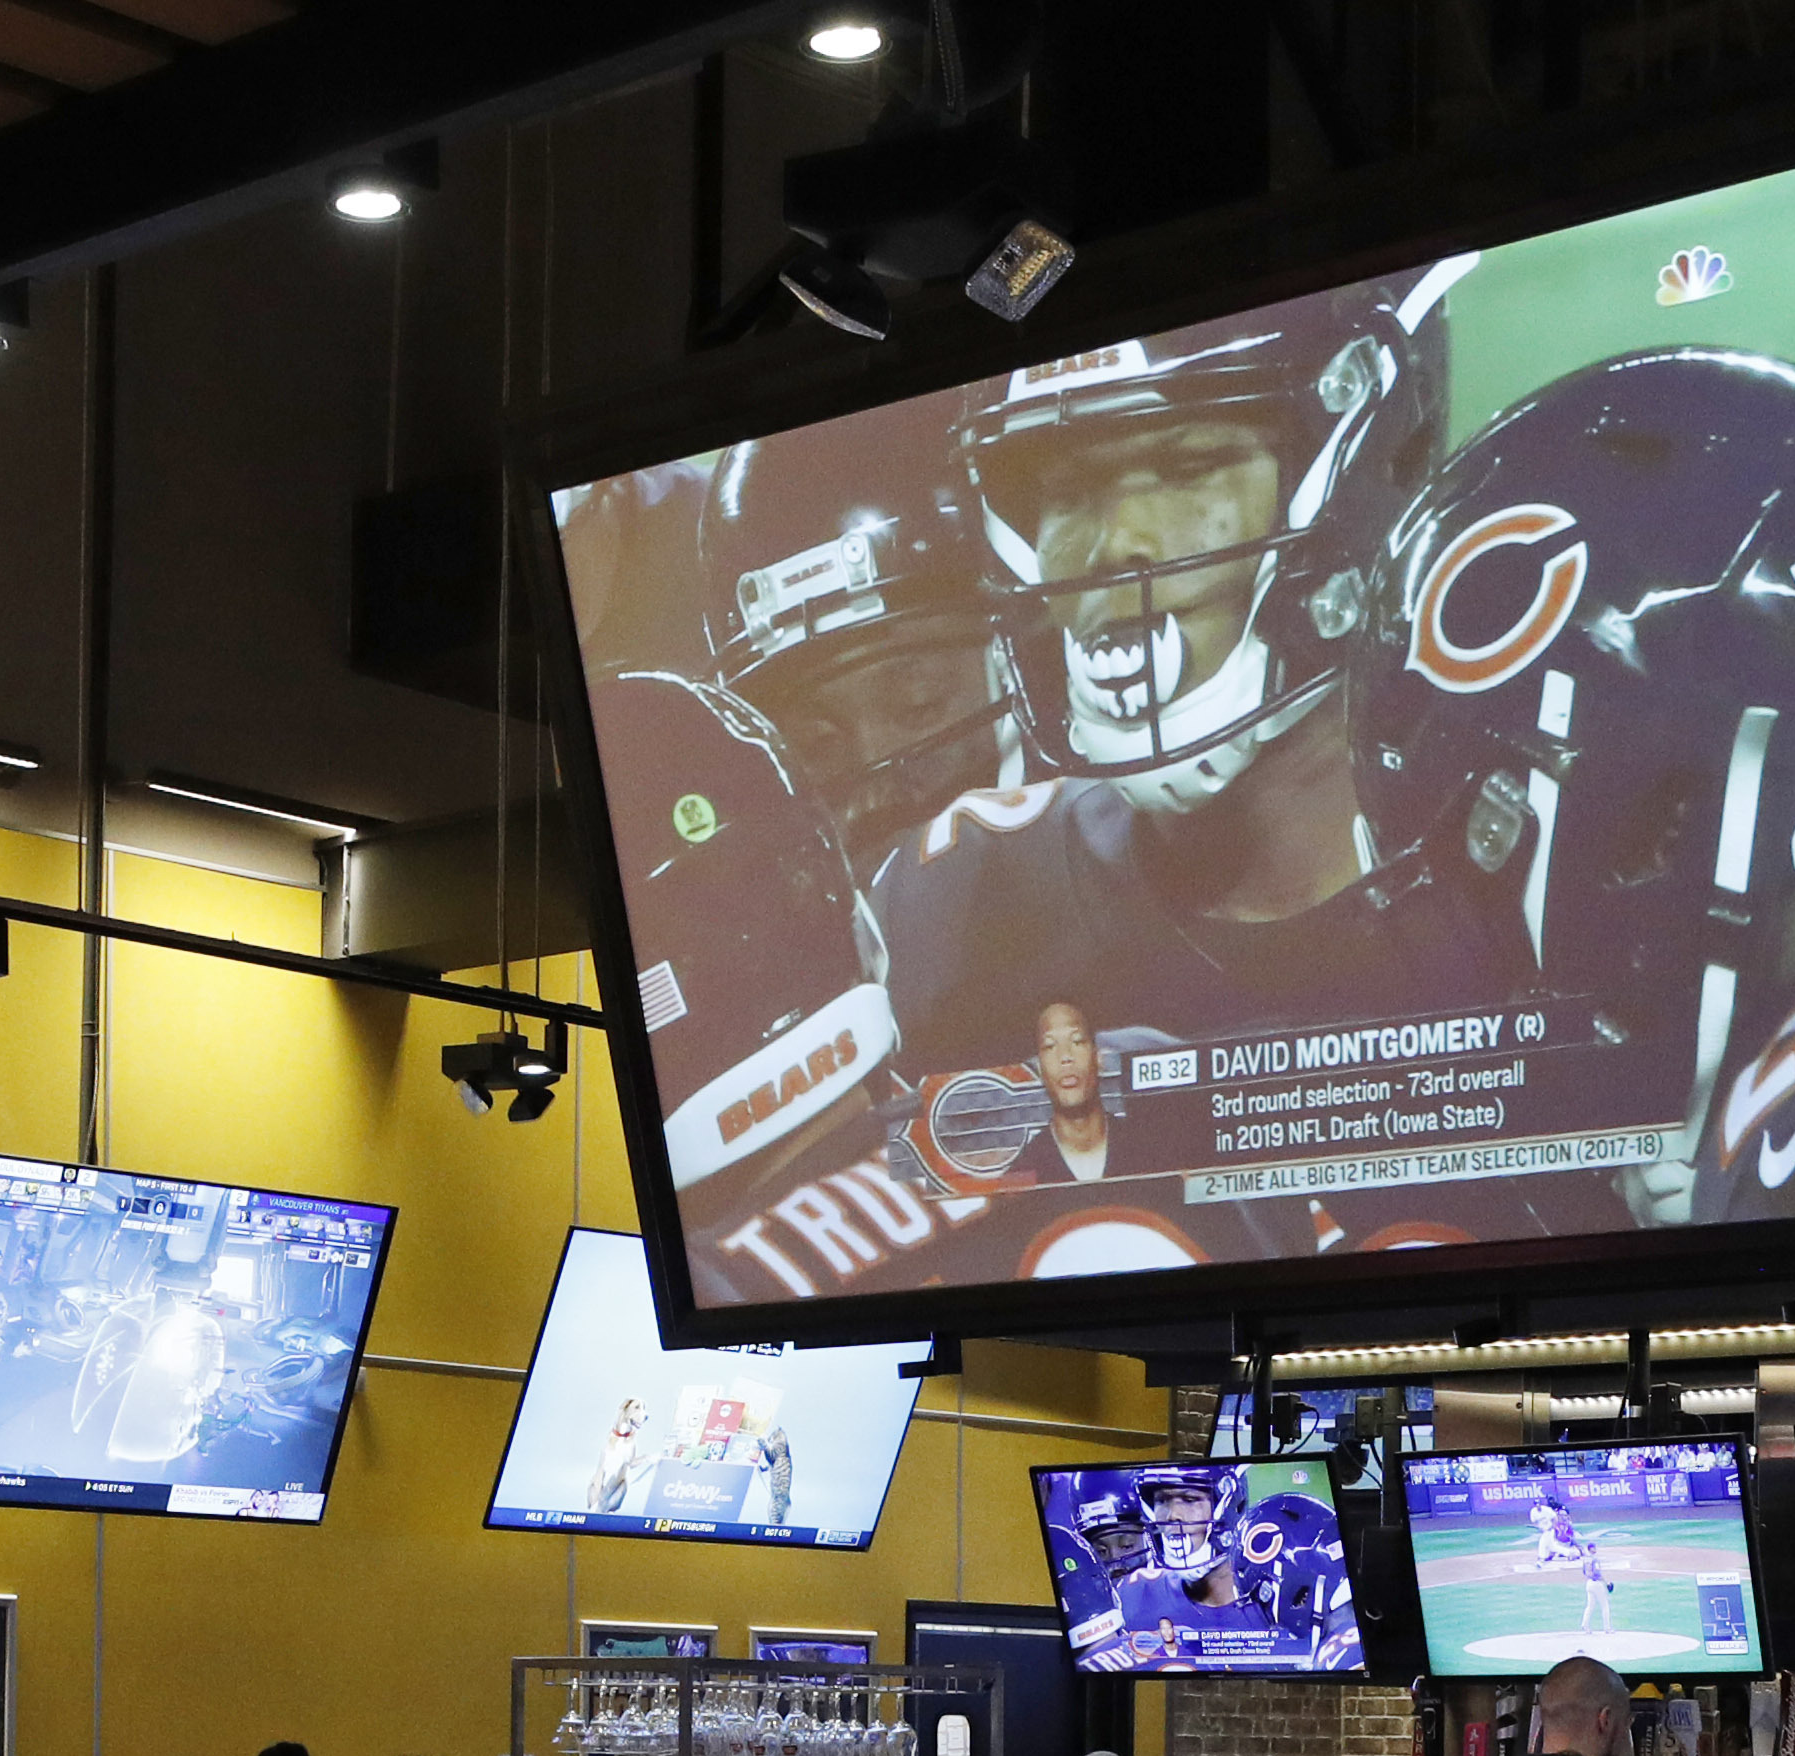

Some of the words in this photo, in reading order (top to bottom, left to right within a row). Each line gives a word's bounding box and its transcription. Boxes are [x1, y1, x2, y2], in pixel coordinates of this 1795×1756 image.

[1139, 1062, 1163, 1083] RB
[1168, 1057, 1191, 1080] 32
[1211, 1041, 1290, 1080] DAVID
[1295, 1014, 1504, 1070] MONTGOMERY
[1514, 1011, 1546, 1043] (R)
[715, 1029, 861, 1146] BEARS
[1212, 1090, 1245, 1118] 3rd
[1248, 1084, 1302, 1115] round
[1305, 1078, 1391, 1109] selection
[1407, 1067, 1455, 1099] 73rd
[1458, 1059, 1526, 1094] overall
[1215, 1128, 1233, 1152] in
[1236, 1121, 1284, 1151] 2019
[1288, 1118, 1327, 1145] NFL
[1329, 1111, 1380, 1142] Draft
[1383, 1107, 1438, 1141] (Iowa
[1442, 1097, 1506, 1130] State)
[1206, 1170, 1265, 1196] 2-TIME
[1268, 1163, 1336, 1190] ALL-BIG
[1340, 1164, 1357, 1182] 12
[1362, 1157, 1412, 1181] FIRST
[1415, 1152, 1467, 1176] TEAM
[1471, 1142, 1571, 1172] SELECTION
[1576, 1132, 1663, 1166] (2017-18)
[269, 1196, 314, 1212] VANCOUVER
[314, 1203, 341, 1215] TITANS
[285, 1482, 305, 1492] LIVE
[1646, 1483, 1667, 1495] HAT
[671, 1520, 716, 1533] PITTSBURGH
